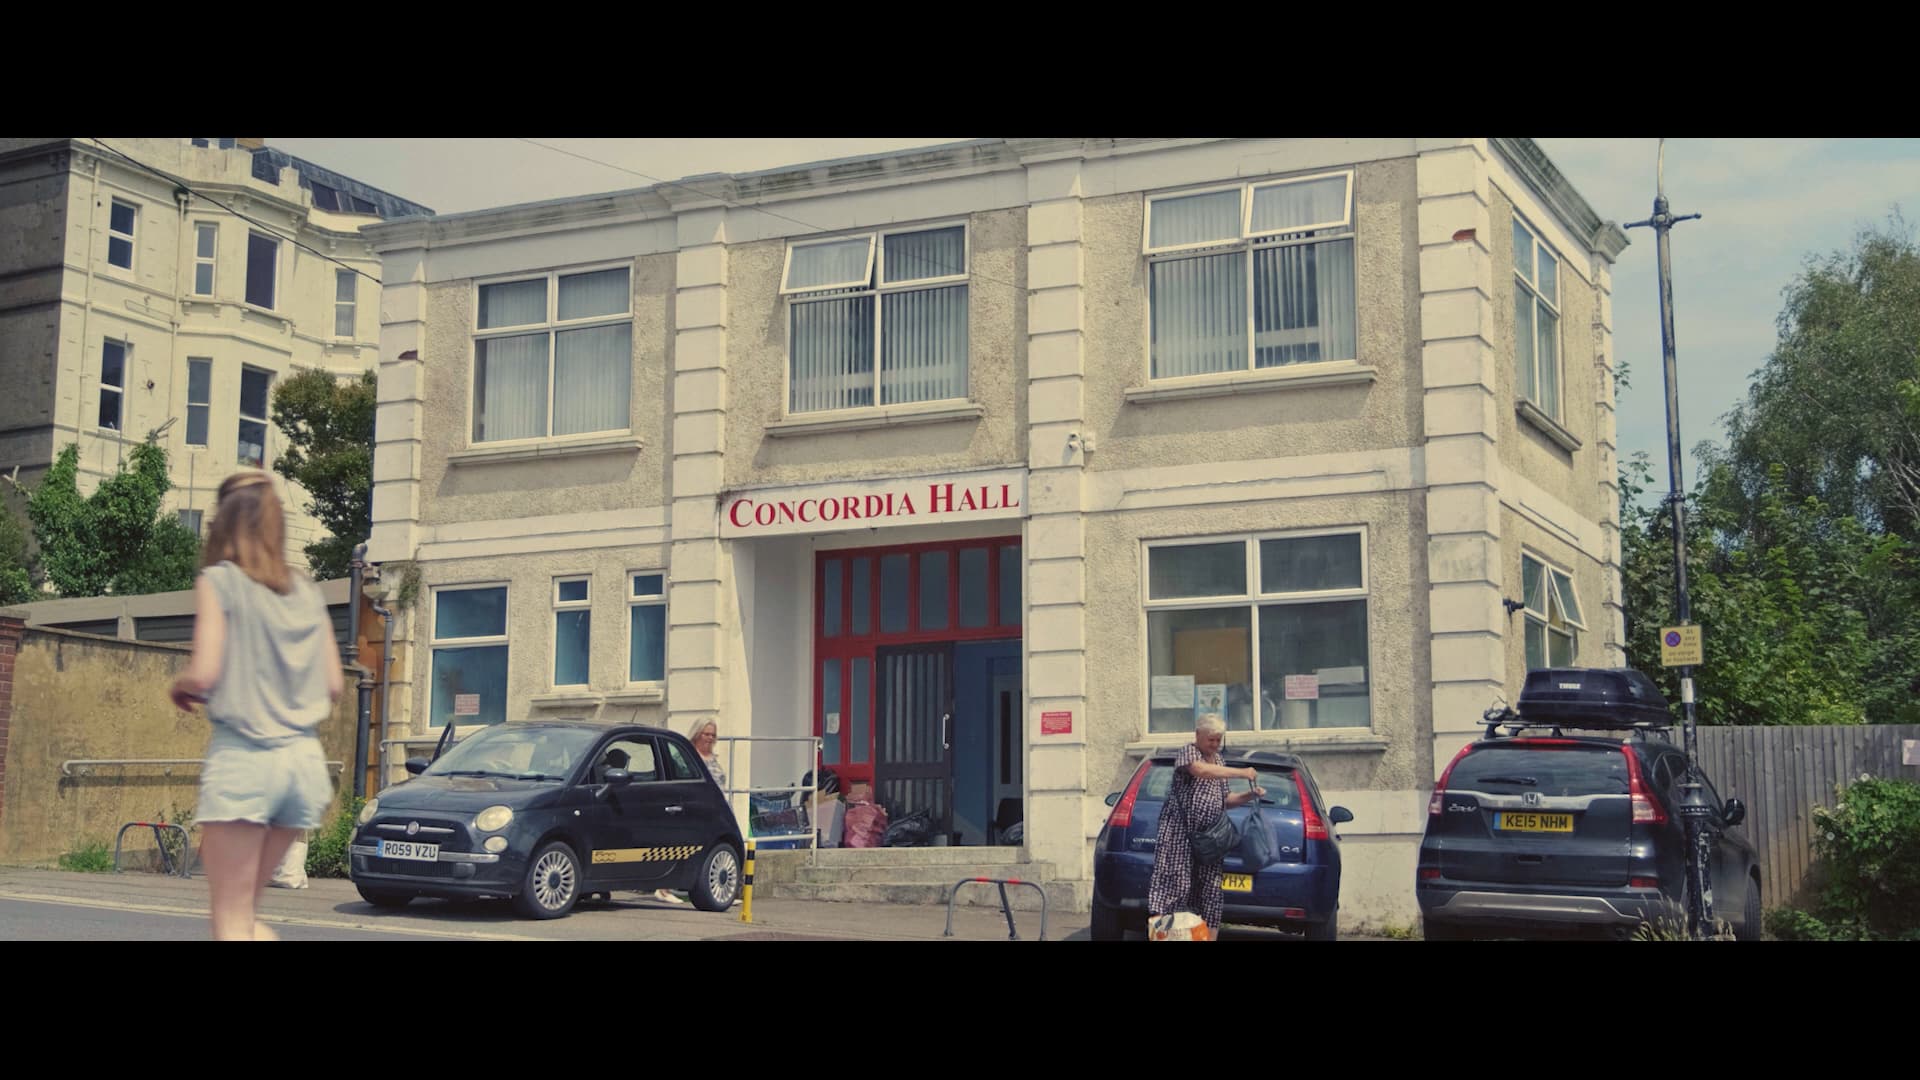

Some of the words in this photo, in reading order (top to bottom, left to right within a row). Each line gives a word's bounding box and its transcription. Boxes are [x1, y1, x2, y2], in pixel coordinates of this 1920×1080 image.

[729, 493, 915, 527] CONCORDIA
[928, 483, 1020, 514] HALL
[1505, 815, 1537, 828] KE15
[1540, 817, 1568, 829] NHM
[415, 845, 436, 858] VZU
